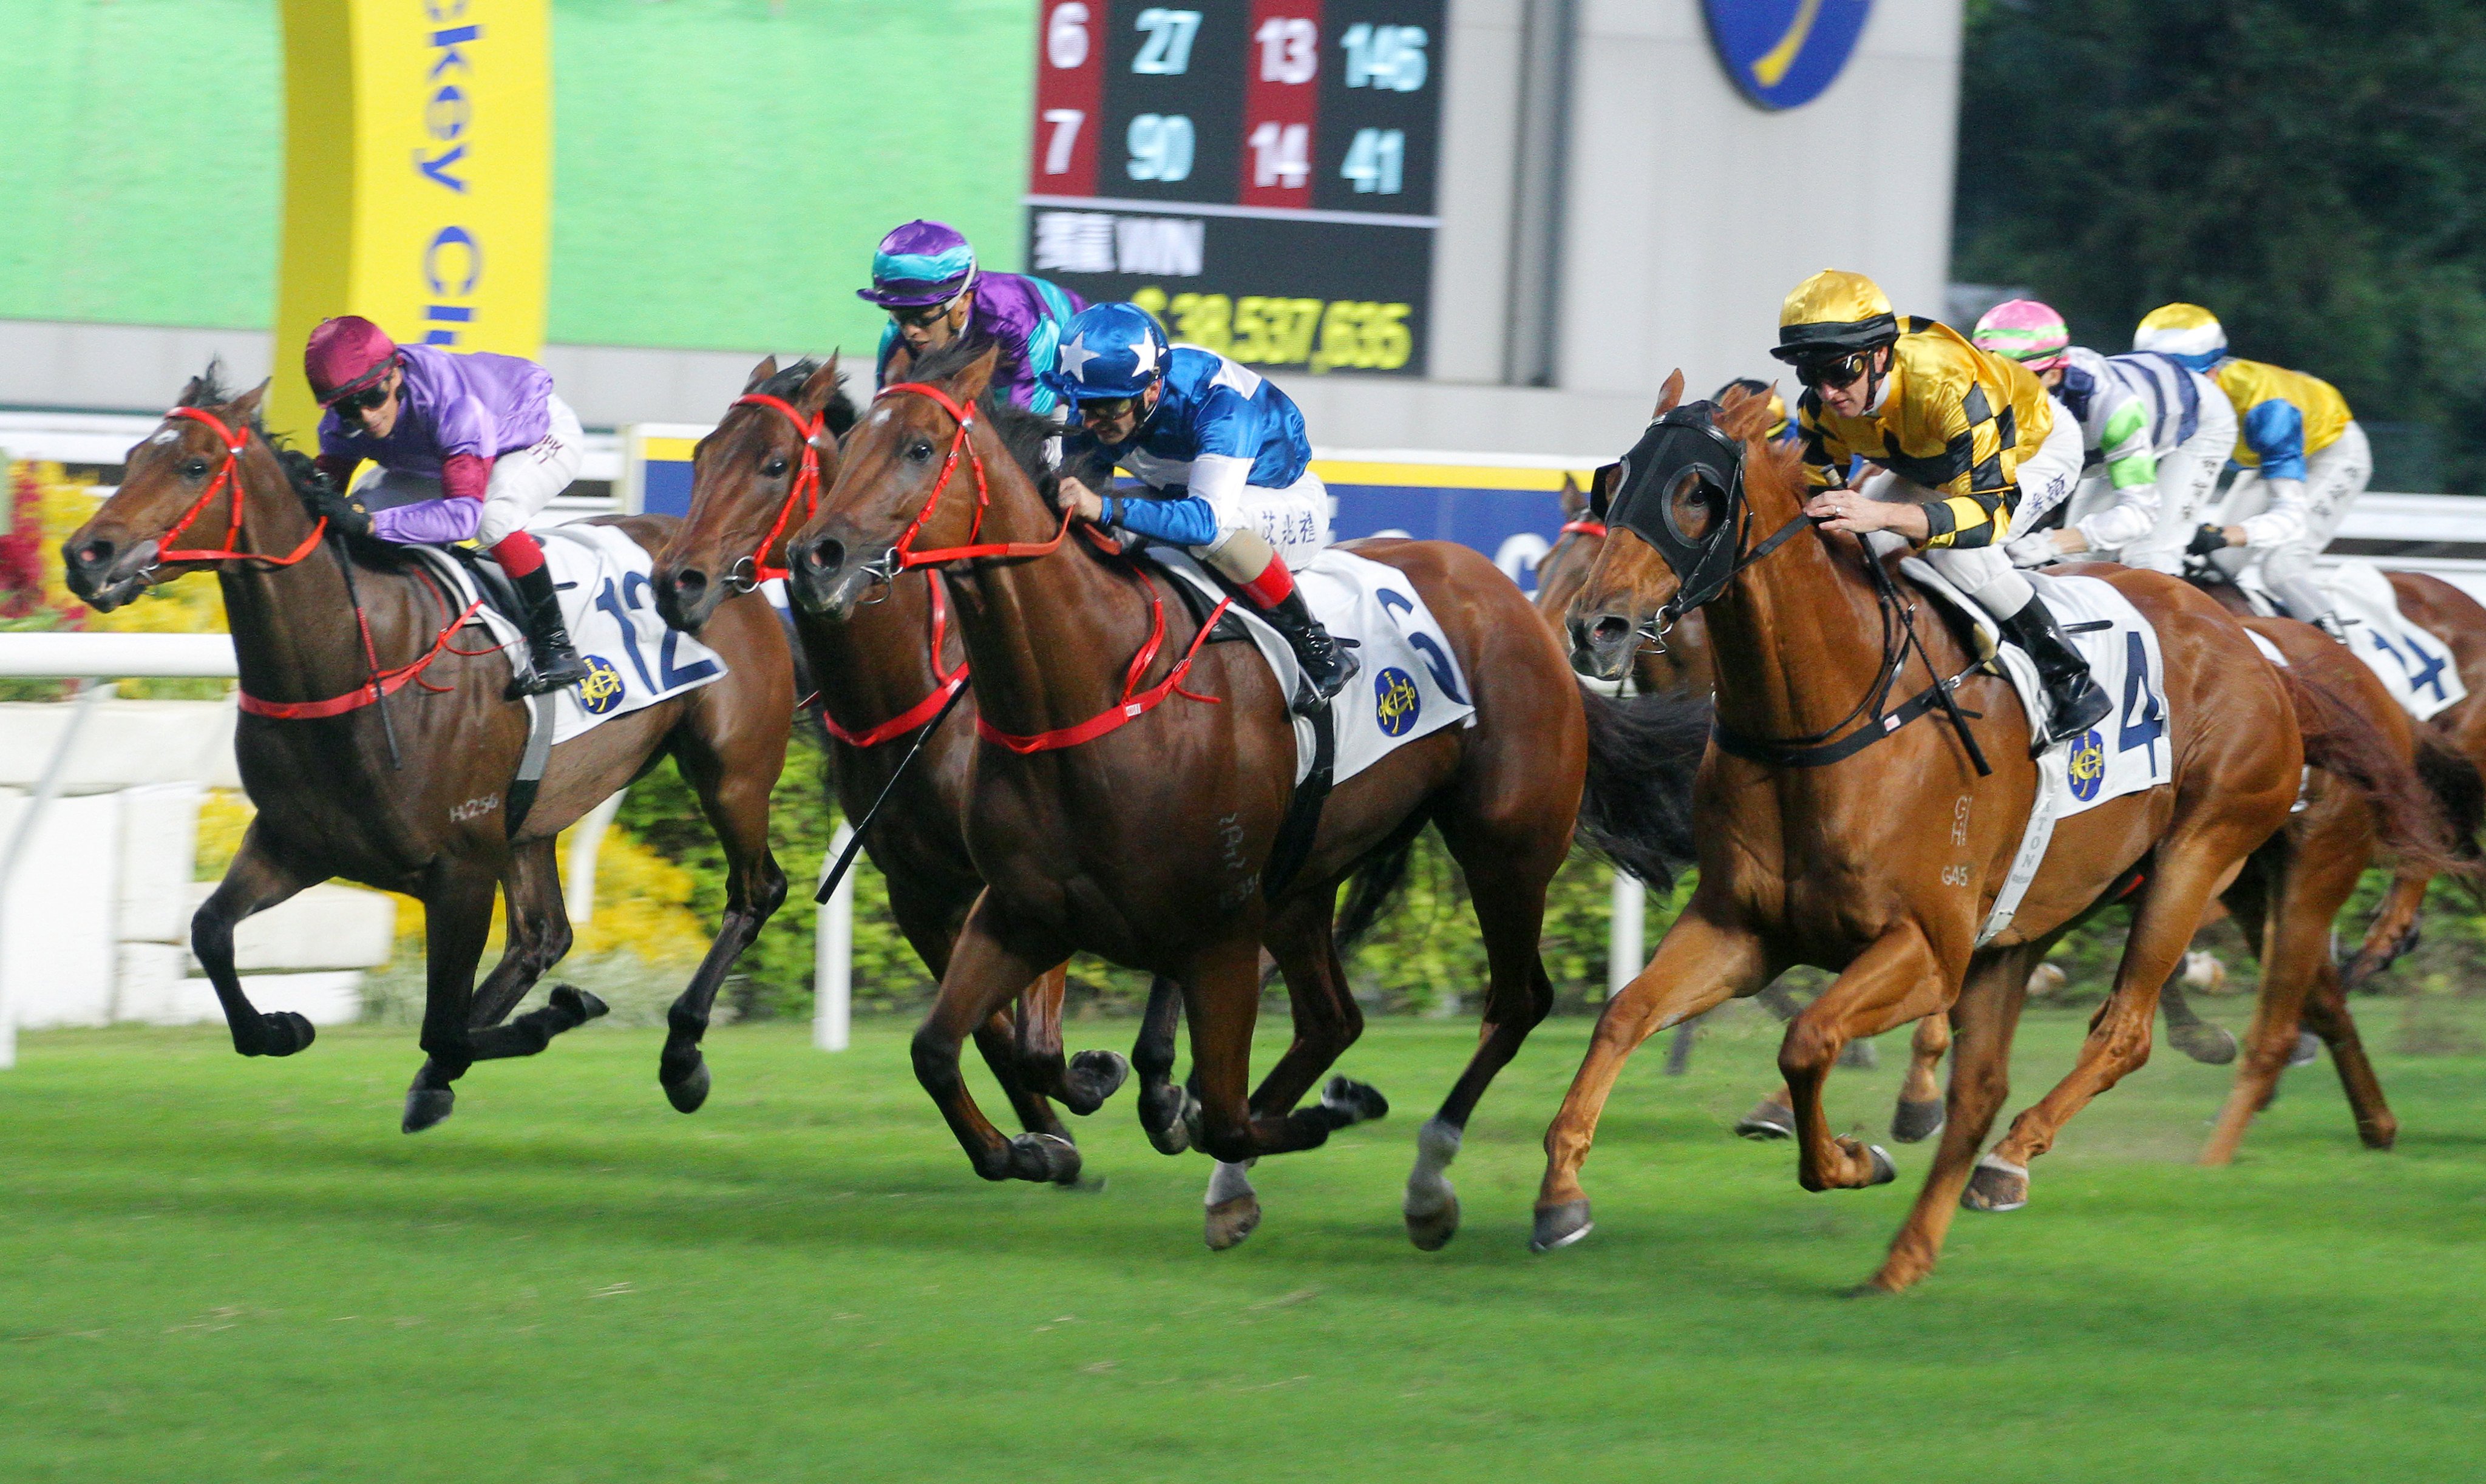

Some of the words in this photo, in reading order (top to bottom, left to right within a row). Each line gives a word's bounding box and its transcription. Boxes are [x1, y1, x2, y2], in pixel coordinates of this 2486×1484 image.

[1047, 2, 1090, 69] 6
[1131, 8, 1203, 75] 27
[1255, 17, 1318, 84] 13
[1340, 22, 1429, 92] 146
[1043, 109, 1085, 175] 7
[1127, 113, 1196, 181] 90
[1249, 123, 1311, 189] 14
[1339, 127, 1404, 195] 41
[595, 571, 720, 696] 12
[2368, 628, 2447, 702] 14
[2119, 631, 2162, 778] 4
[1941, 864, 1968, 887] G45
